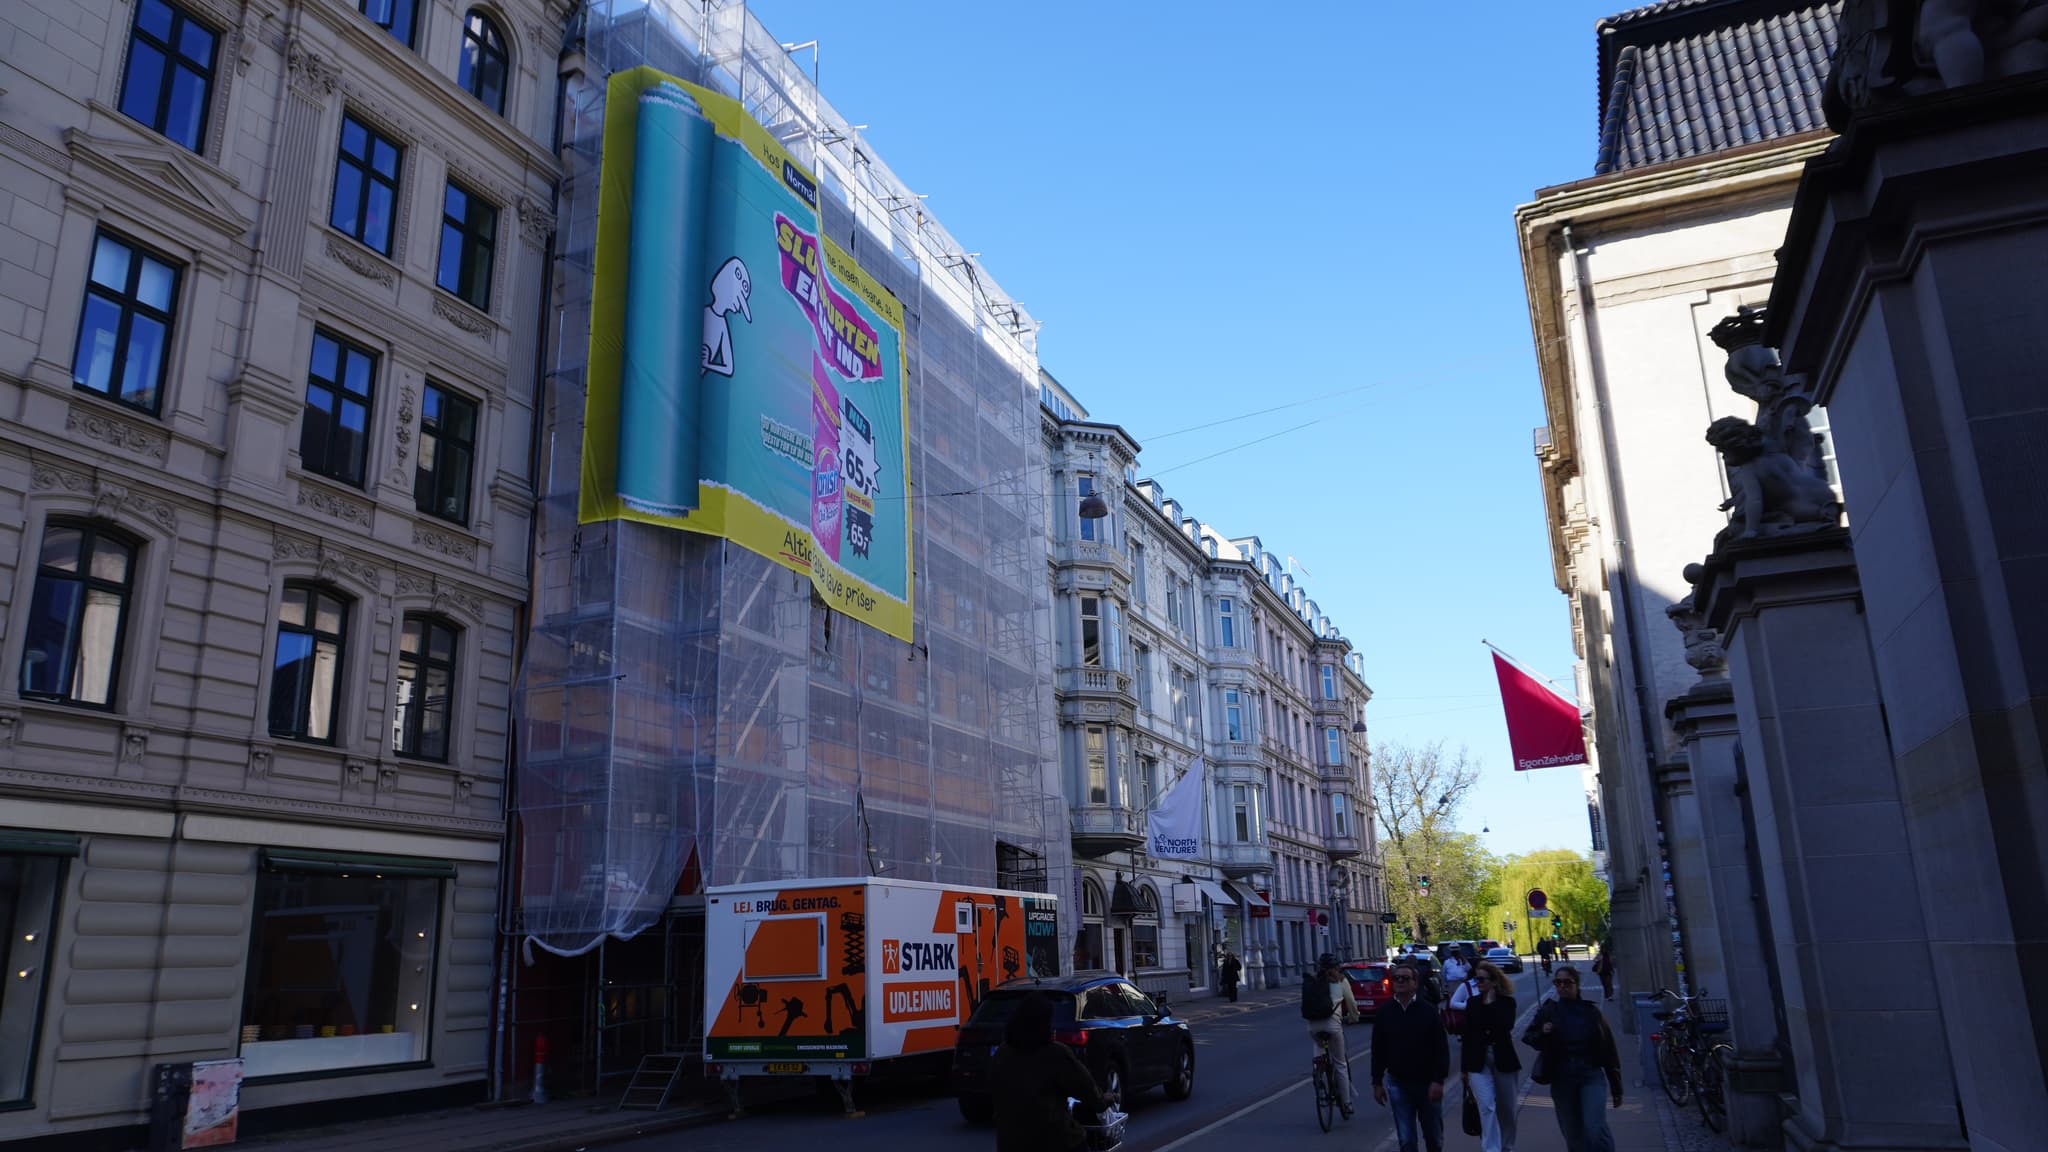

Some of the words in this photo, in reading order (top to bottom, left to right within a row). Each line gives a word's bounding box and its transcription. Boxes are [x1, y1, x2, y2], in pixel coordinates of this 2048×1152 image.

[763, 144, 780, 169] Hos
[786, 164, 817, 205] Normal
[836, 337, 864, 377] IND
[845, 587, 877, 612] priser
[1155, 845, 1197, 854] VENTURES
[1168, 838, 1197, 847] NORTH
[734, 901, 754, 914] LEJ.
[756, 899, 791, 913] BRUG.
[793, 896, 841, 911] GENTAG.
[1028, 911, 1056, 921] UPGRADE
[1028, 921, 1056, 937] NOW!
[901, 942, 955, 972] STARK
[889, 988, 952, 1016] UDLEJNING
